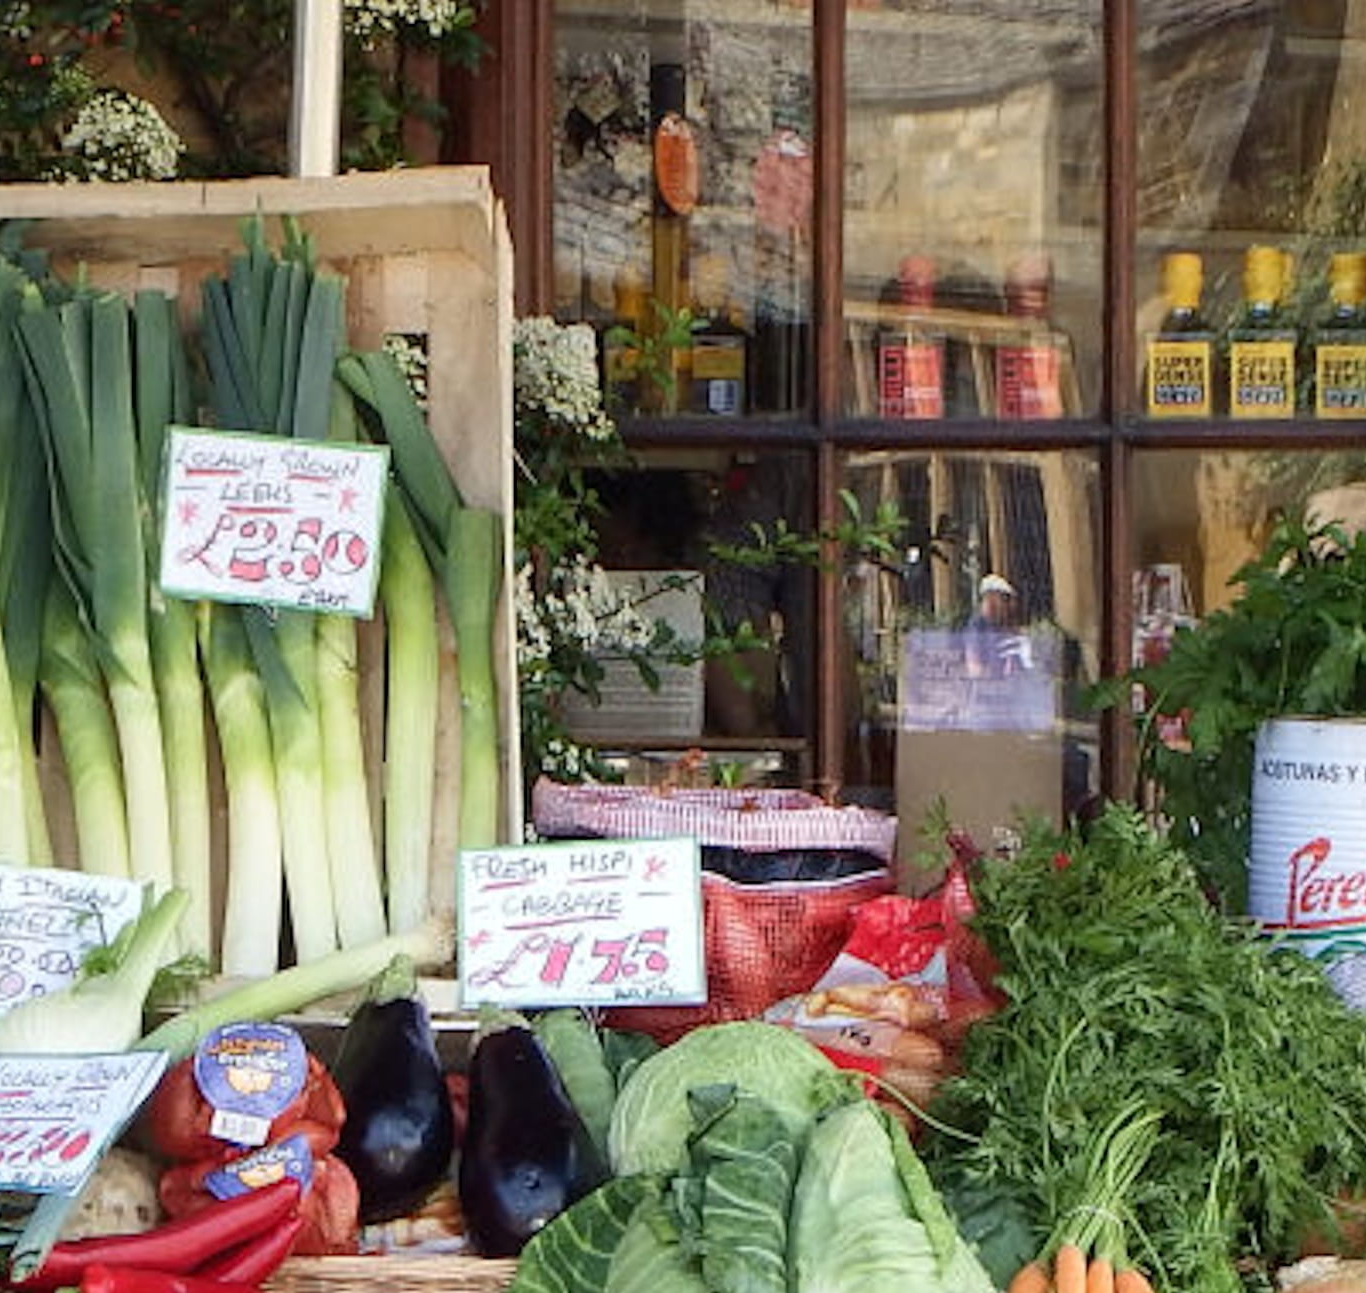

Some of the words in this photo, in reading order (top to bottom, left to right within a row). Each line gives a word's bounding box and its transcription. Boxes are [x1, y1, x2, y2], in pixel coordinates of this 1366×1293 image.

[1346, 766, 1359, 783] Y
[472, 854, 547, 880] FRESH
[570, 853, 633, 873] HISPI
[501, 889, 623, 917] CABBAGE
[468, 928, 671, 989] £1.75
